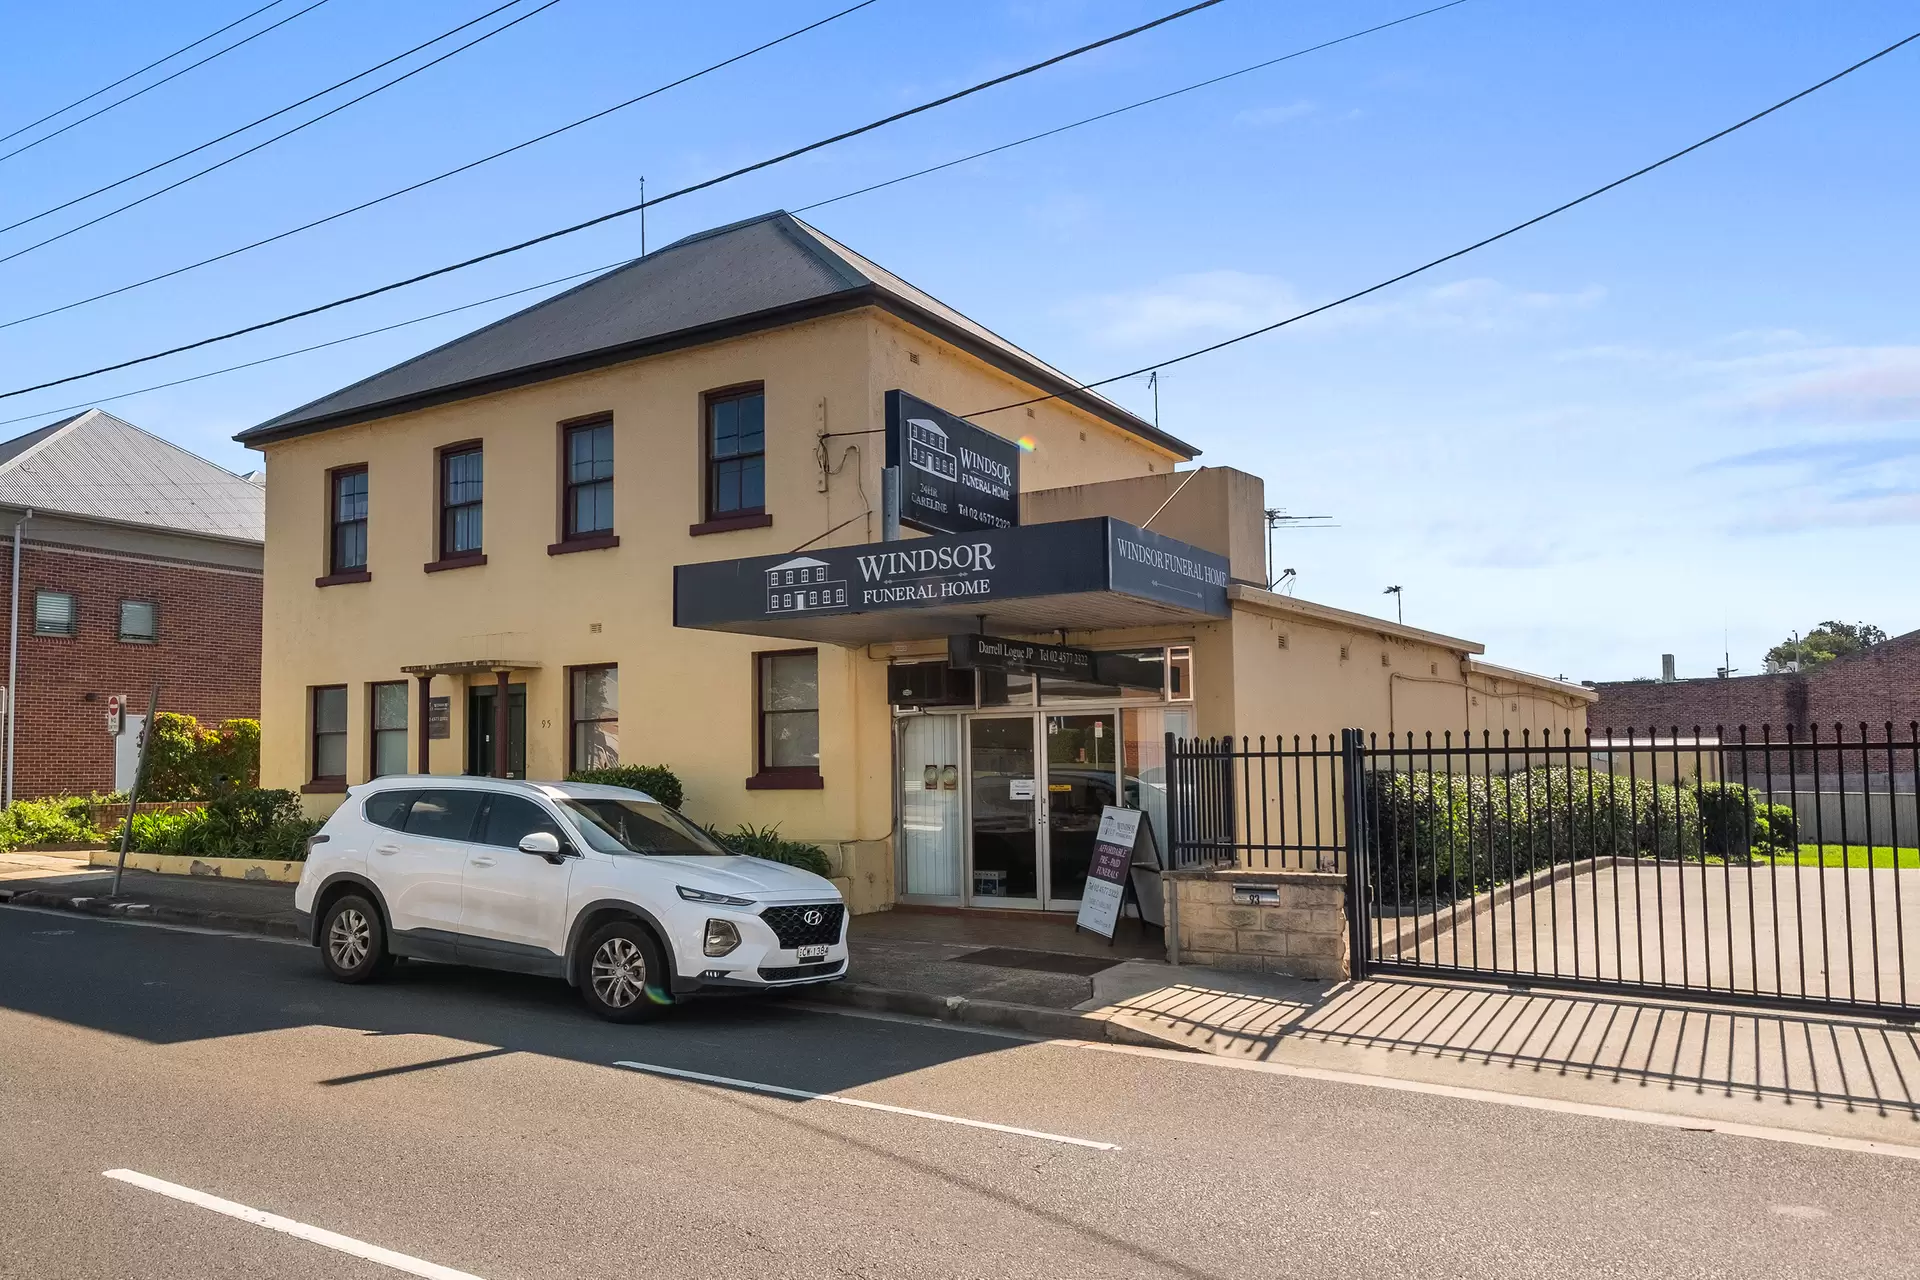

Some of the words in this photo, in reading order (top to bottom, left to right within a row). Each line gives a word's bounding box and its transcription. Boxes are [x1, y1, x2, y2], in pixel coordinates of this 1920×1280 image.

[960, 446, 1012, 487] WINDSOR
[919, 483, 938, 498] 24HR
[962, 473, 992, 494] FUNERAL
[991, 484, 1010, 501] HOME
[911, 492, 949, 514] CARELINE
[958, 503, 968, 517] Tel
[969, 507, 978, 521] 02
[979, 511, 995, 526] 4577
[856, 542, 996, 583] WINDSOR
[1117, 537, 1164, 569] WINDSOR
[1164, 552, 1204, 581] FUNERAL
[1203, 565, 1228, 588] HOME
[863, 583, 938, 604] FUNERAL
[940, 578, 991, 598] HOME
[978, 640, 1003, 656] Darrell
[1004, 644, 1025, 661] Logue
[1025, 647, 1034, 660] JP
[1040, 649, 1049, 661] Tel
[1049, 650, 1058, 663] 02
[1058, 652, 1073, 664] 4577
[541, 719, 552, 729] 95
[1099, 844, 1128, 858] AFFORDABLE
[1096, 865, 1120, 880] FUNERALS
[1249, 894, 1260, 905] 93
